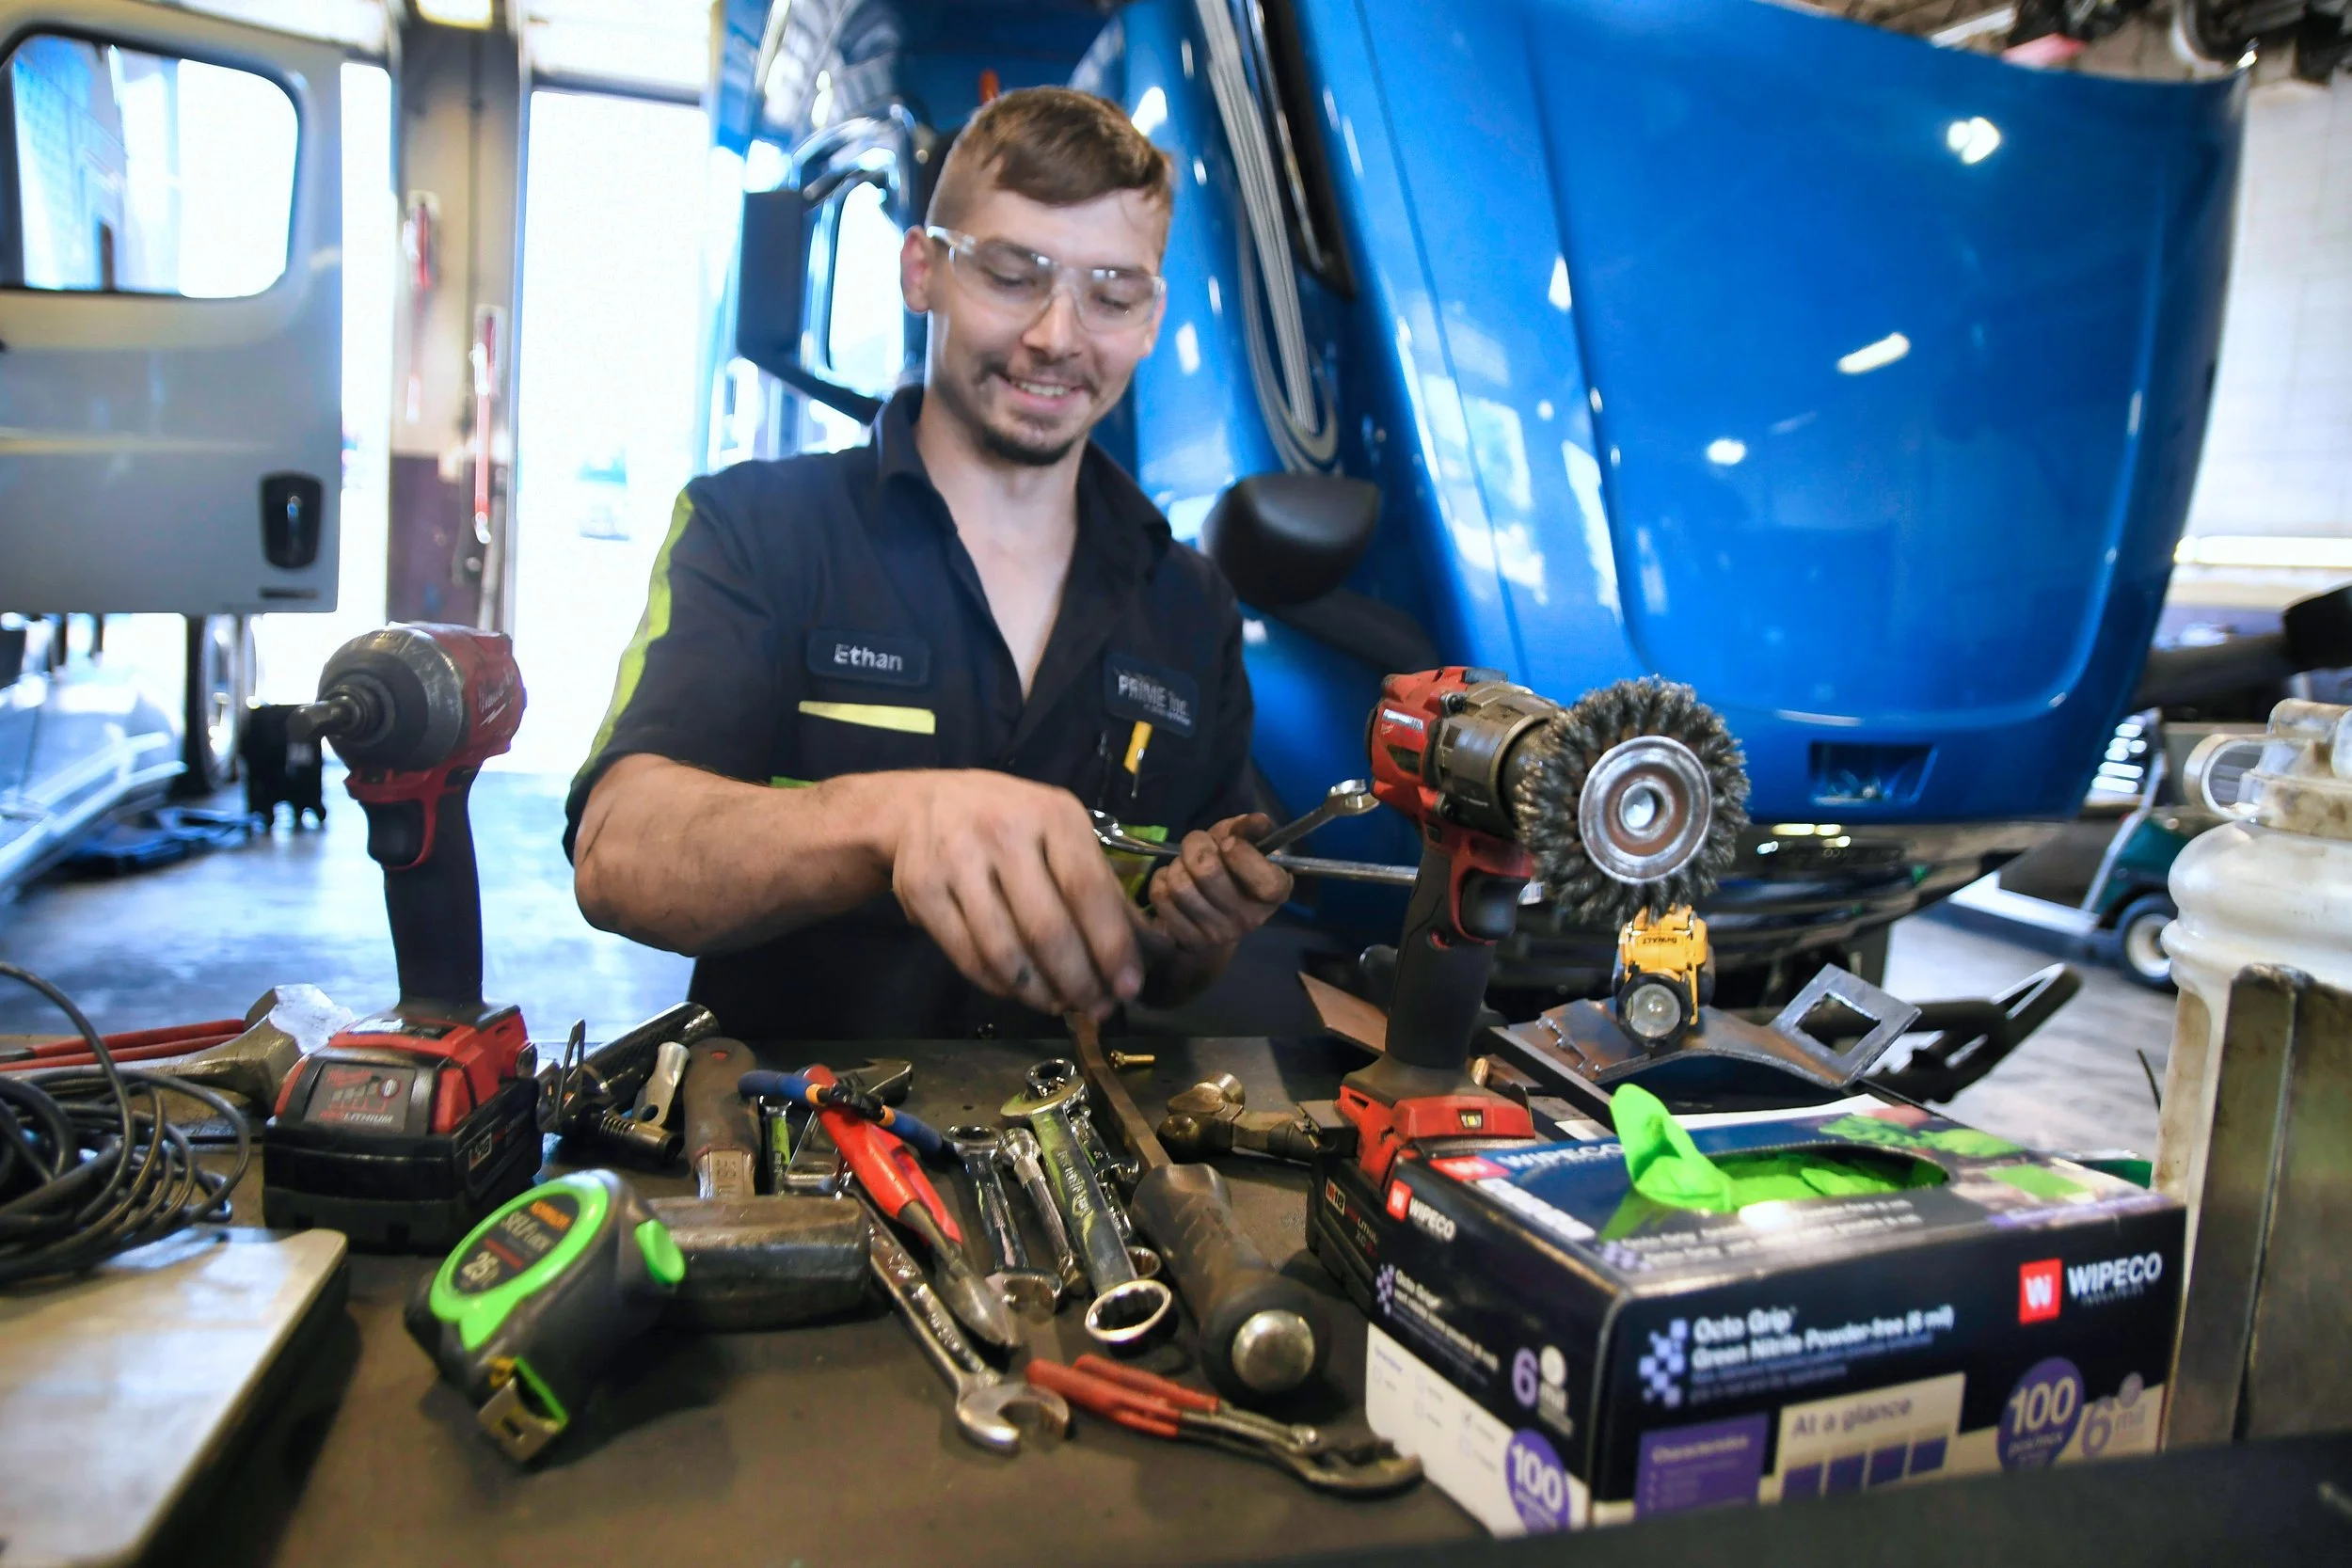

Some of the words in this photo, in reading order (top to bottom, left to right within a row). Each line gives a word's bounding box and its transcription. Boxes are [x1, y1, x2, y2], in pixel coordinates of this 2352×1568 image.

[834, 643, 903, 673] Ethan
[1408, 1196, 1456, 1242] WIPECO
[2067, 1252, 2163, 1300] WIPECO
[1693, 1316, 1745, 1344] Octo
[1512, 1348, 1539, 1408] 6
[1692, 1345, 1747, 1370] Green
[1791, 1414, 1818, 1437] At
[1842, 1399, 1913, 1433] glance
[2010, 1375, 2077, 1435] 100
[1512, 1442, 1564, 1514] 100
